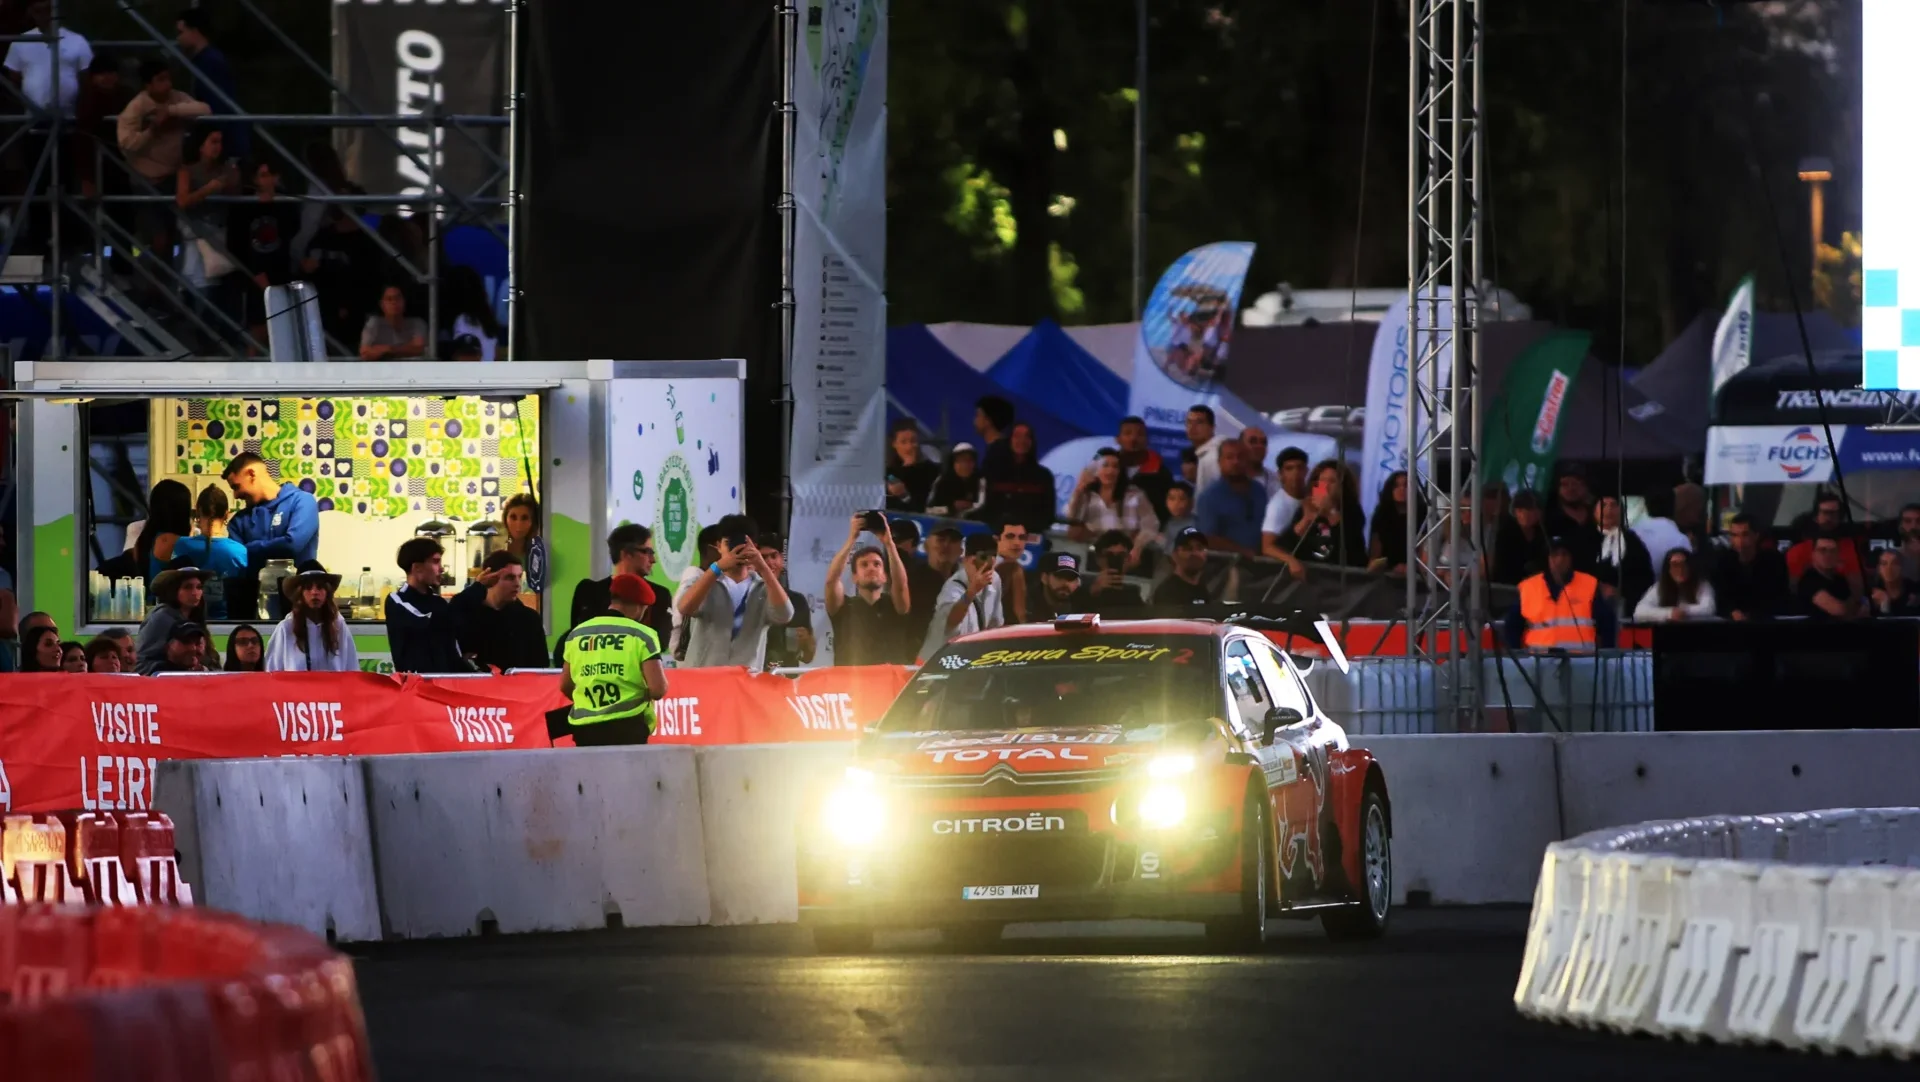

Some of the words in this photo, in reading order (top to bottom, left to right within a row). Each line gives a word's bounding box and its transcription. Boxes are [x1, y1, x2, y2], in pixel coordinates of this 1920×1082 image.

[1768, 446, 1830, 461] FUCHS
[970, 649, 1068, 666] Senra
[1070, 645, 1171, 662] Sport
[1172, 648, 1195, 664] 2
[584, 682, 621, 708] 129
[91, 702, 161, 744] VISITE
[272, 702, 343, 741] VISITE
[786, 693, 857, 731] VISITE
[446, 705, 514, 743] VISITE
[926, 748, 1089, 763] TOTAL
[1011, 885, 1036, 895] MRY
